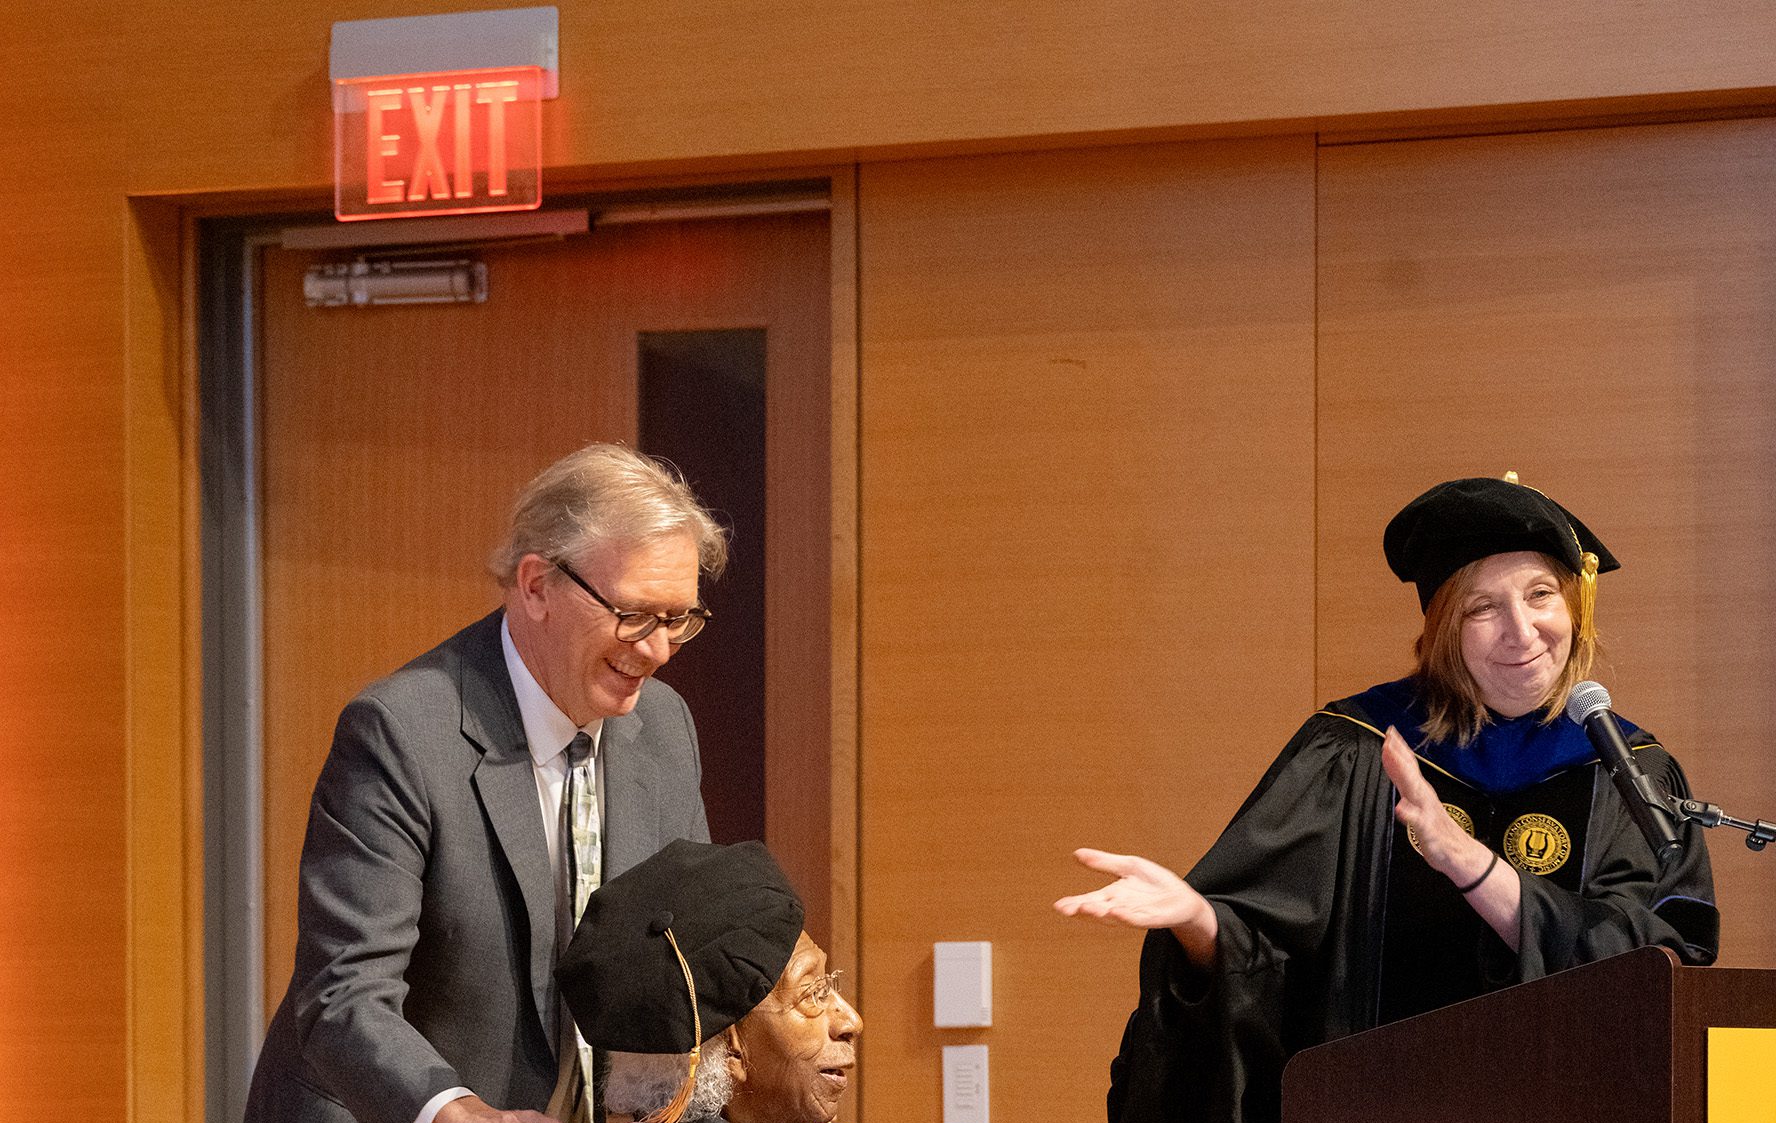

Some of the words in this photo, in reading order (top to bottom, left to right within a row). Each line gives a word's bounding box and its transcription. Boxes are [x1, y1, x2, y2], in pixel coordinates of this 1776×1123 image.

[367, 80, 519, 204] EXIT
[1506, 820, 1521, 853] ENGLAND
[1521, 816, 1568, 849] CONSERVATORY
[1540, 856, 1562, 871] MUSIC
